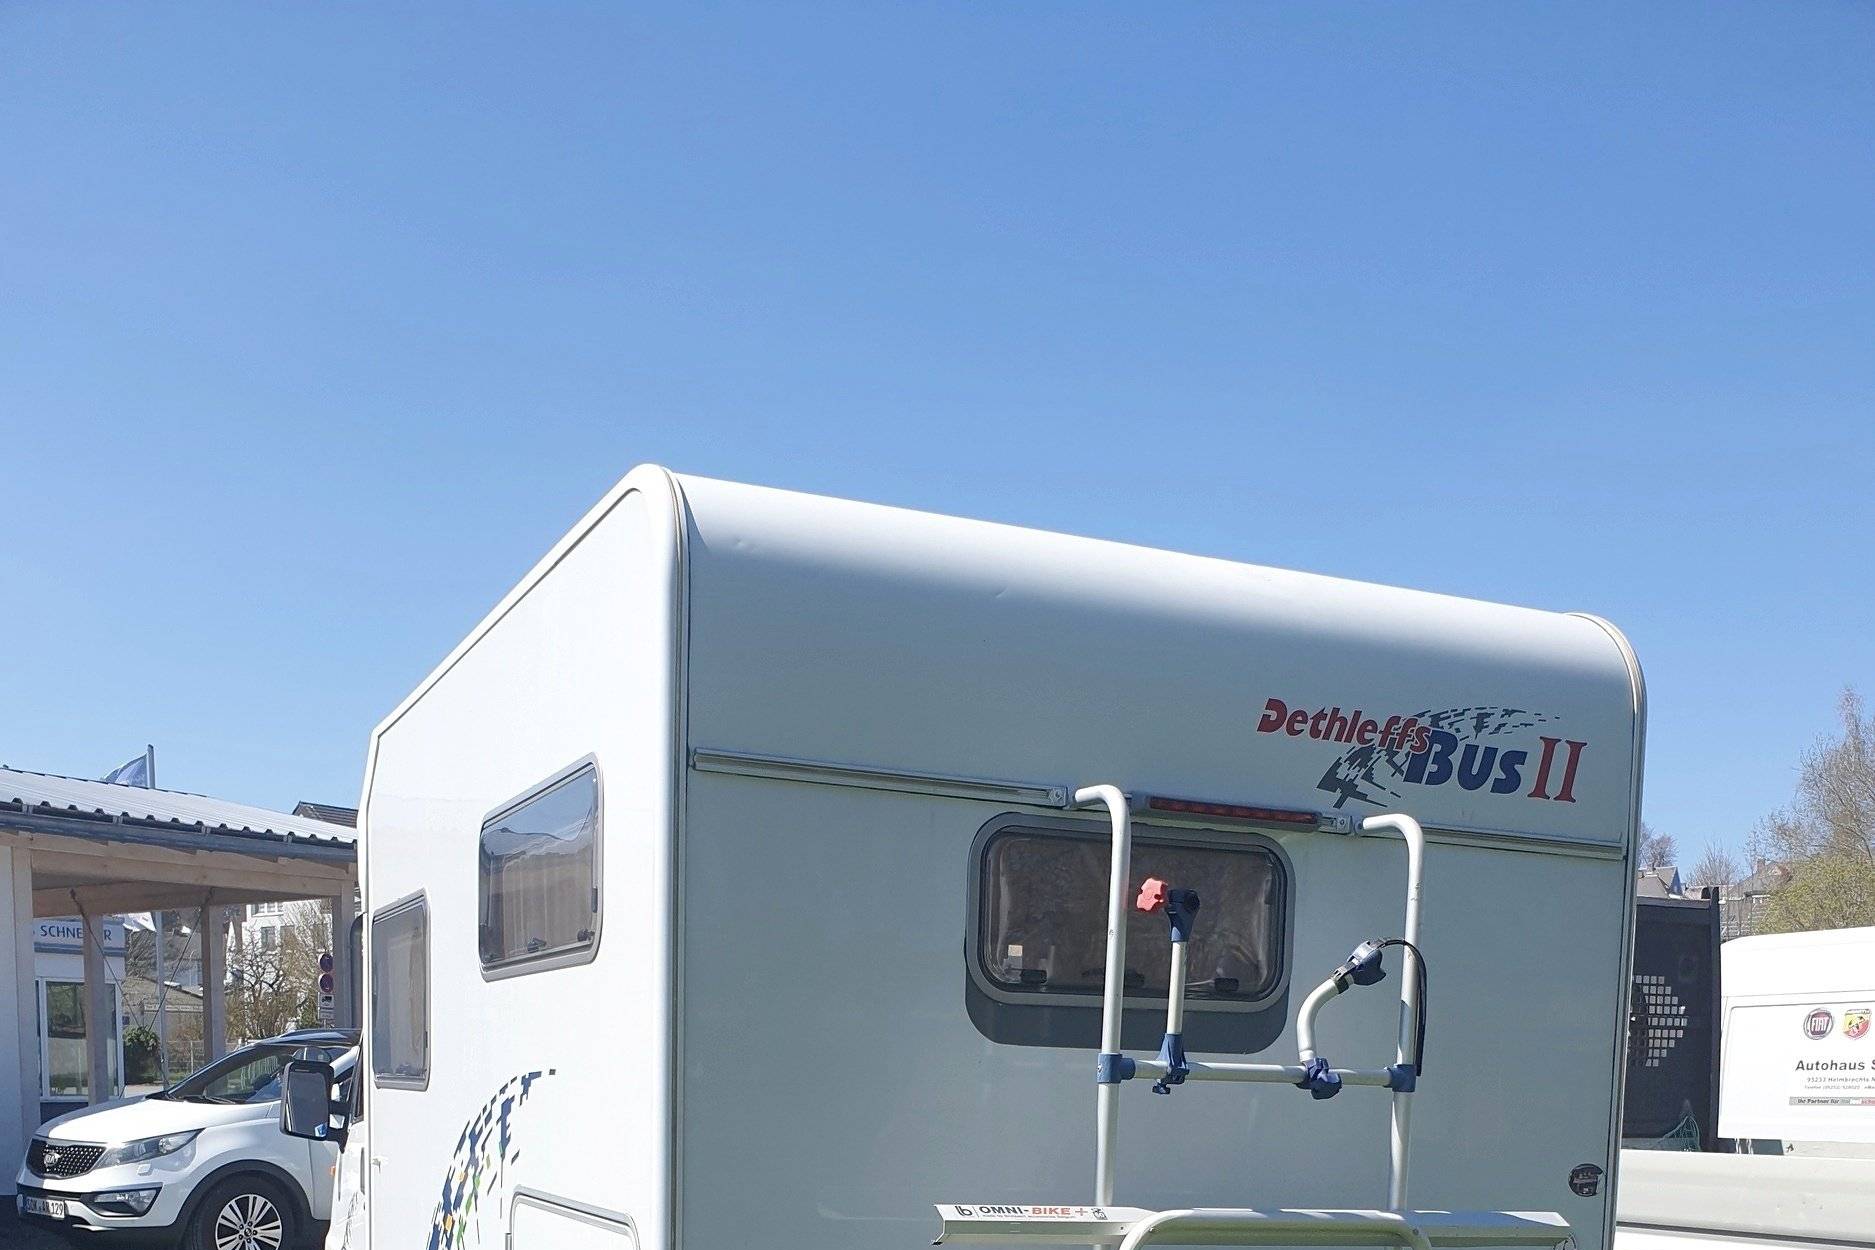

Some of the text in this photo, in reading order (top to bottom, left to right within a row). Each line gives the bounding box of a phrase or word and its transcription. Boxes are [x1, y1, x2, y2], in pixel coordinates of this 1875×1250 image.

[1257, 698, 1434, 753] Dethleffs
[40, 925, 112, 941] SCHNER
[1811, 1017, 1829, 1032] FIAT
[1795, 1059, 1865, 1071] Autohaus
[979, 1206, 1070, 1216] OMNI-BIKE
